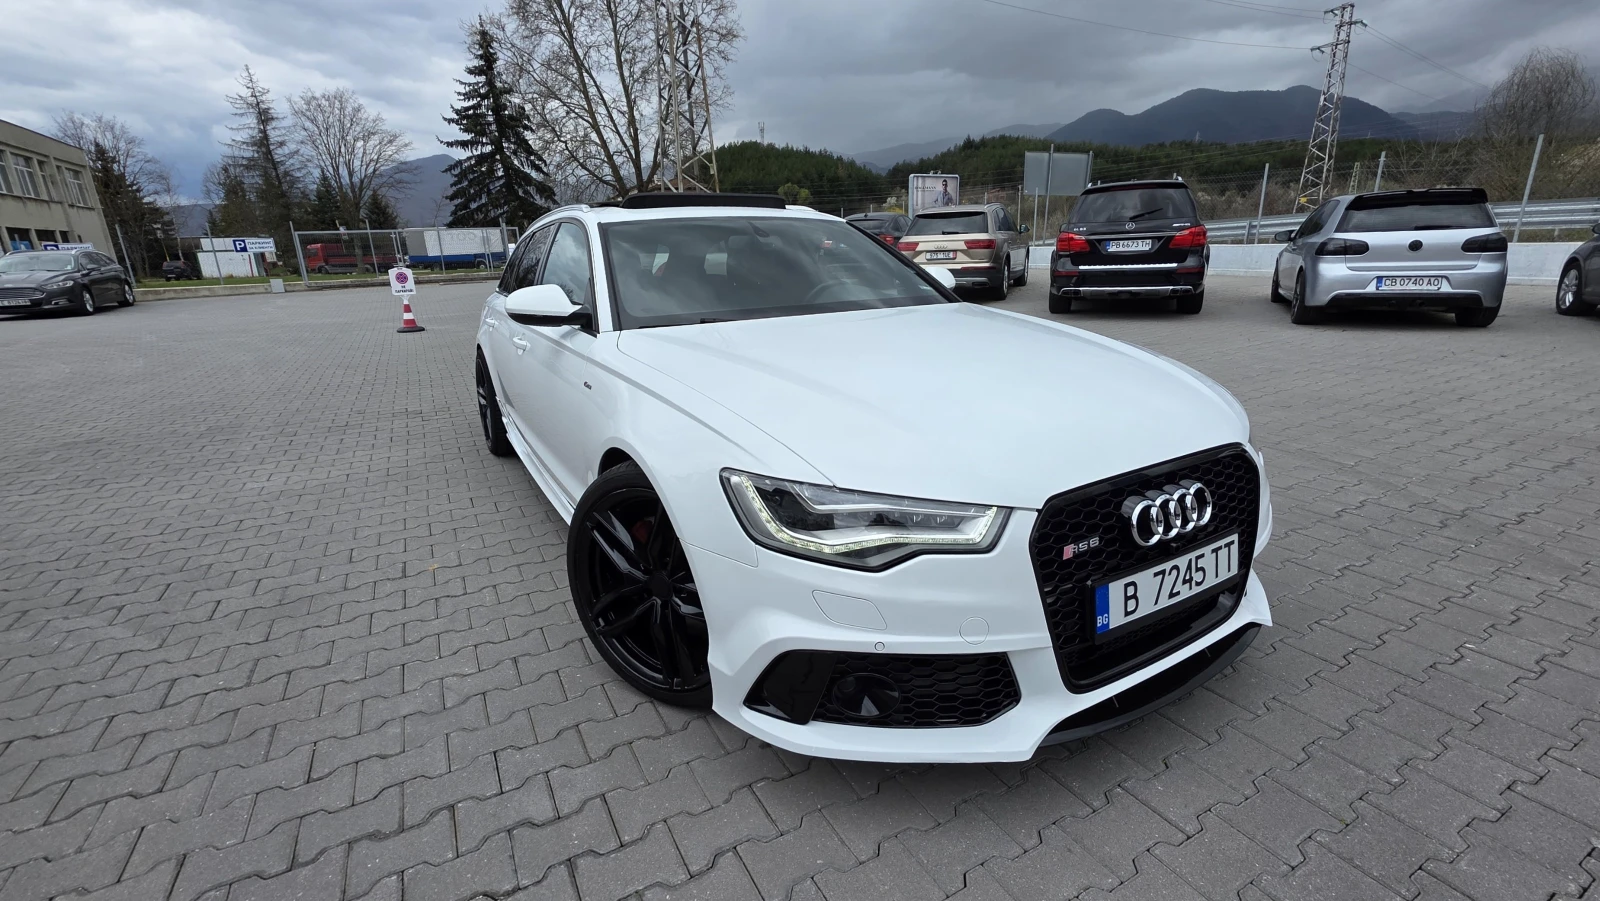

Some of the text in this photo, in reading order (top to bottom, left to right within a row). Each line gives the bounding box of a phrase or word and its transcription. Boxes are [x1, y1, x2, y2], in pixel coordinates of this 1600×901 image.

[1111, 240, 1151, 249] PB 6673 TH
[1383, 278, 1440, 287] CB 0740 AO
[1068, 536, 1100, 556] RS6
[1123, 539, 1236, 618] B 7245 TT
[1096, 613, 1109, 628] BG
